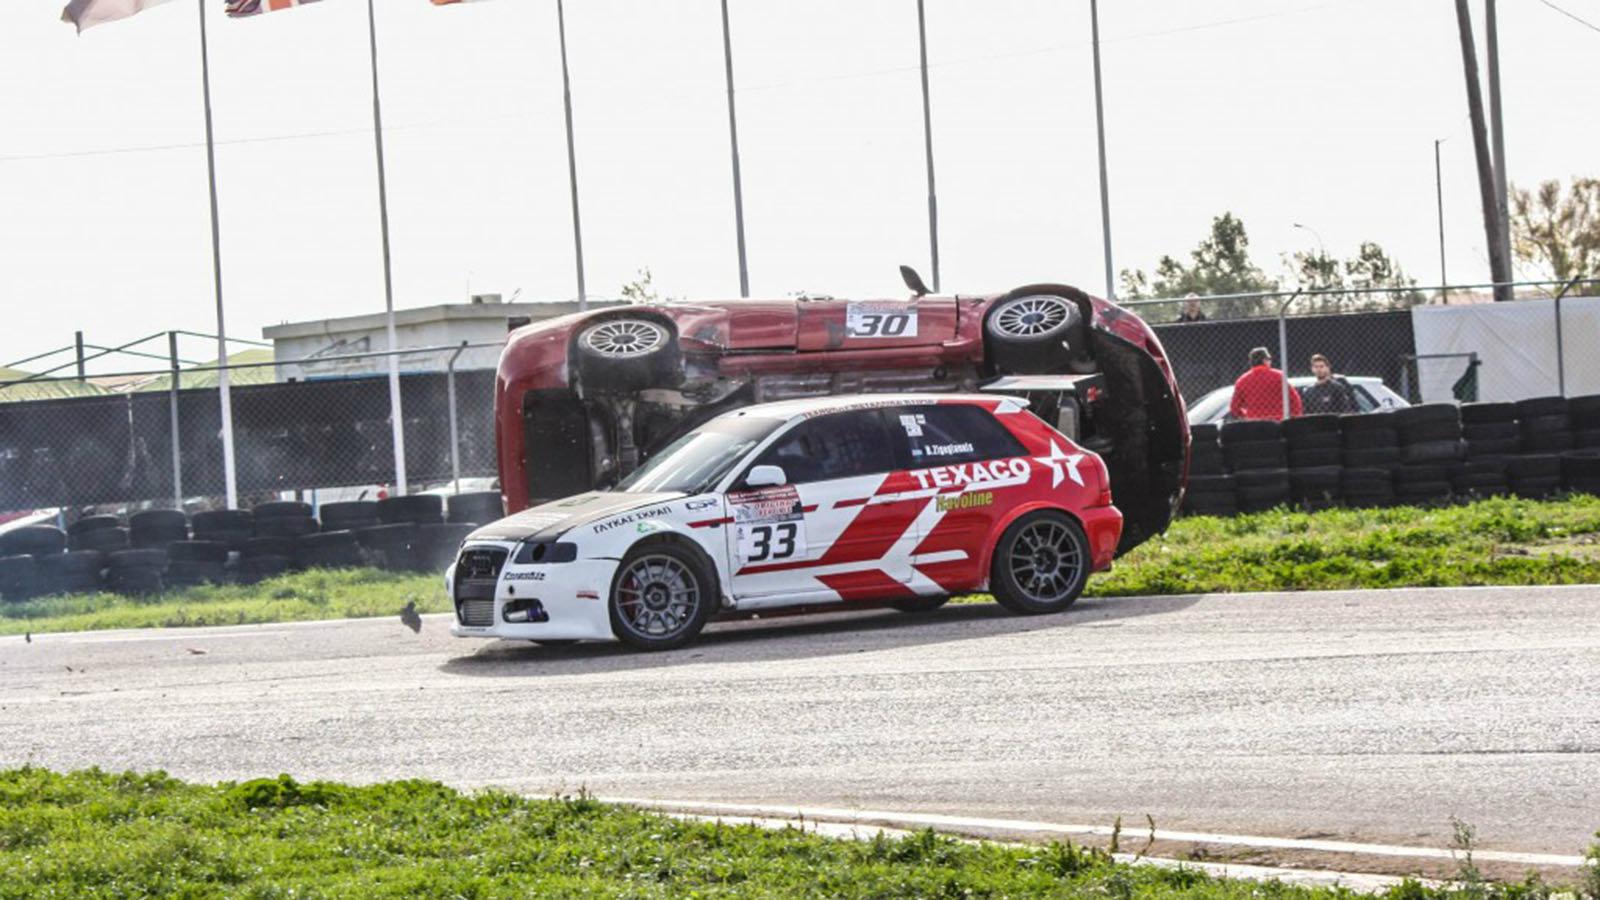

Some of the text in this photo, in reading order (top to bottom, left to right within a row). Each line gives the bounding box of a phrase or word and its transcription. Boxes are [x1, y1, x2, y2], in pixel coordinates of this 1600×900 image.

[855, 315, 910, 336] 30
[910, 458, 1031, 488] TEXACO
[748, 523, 797, 562] 33
